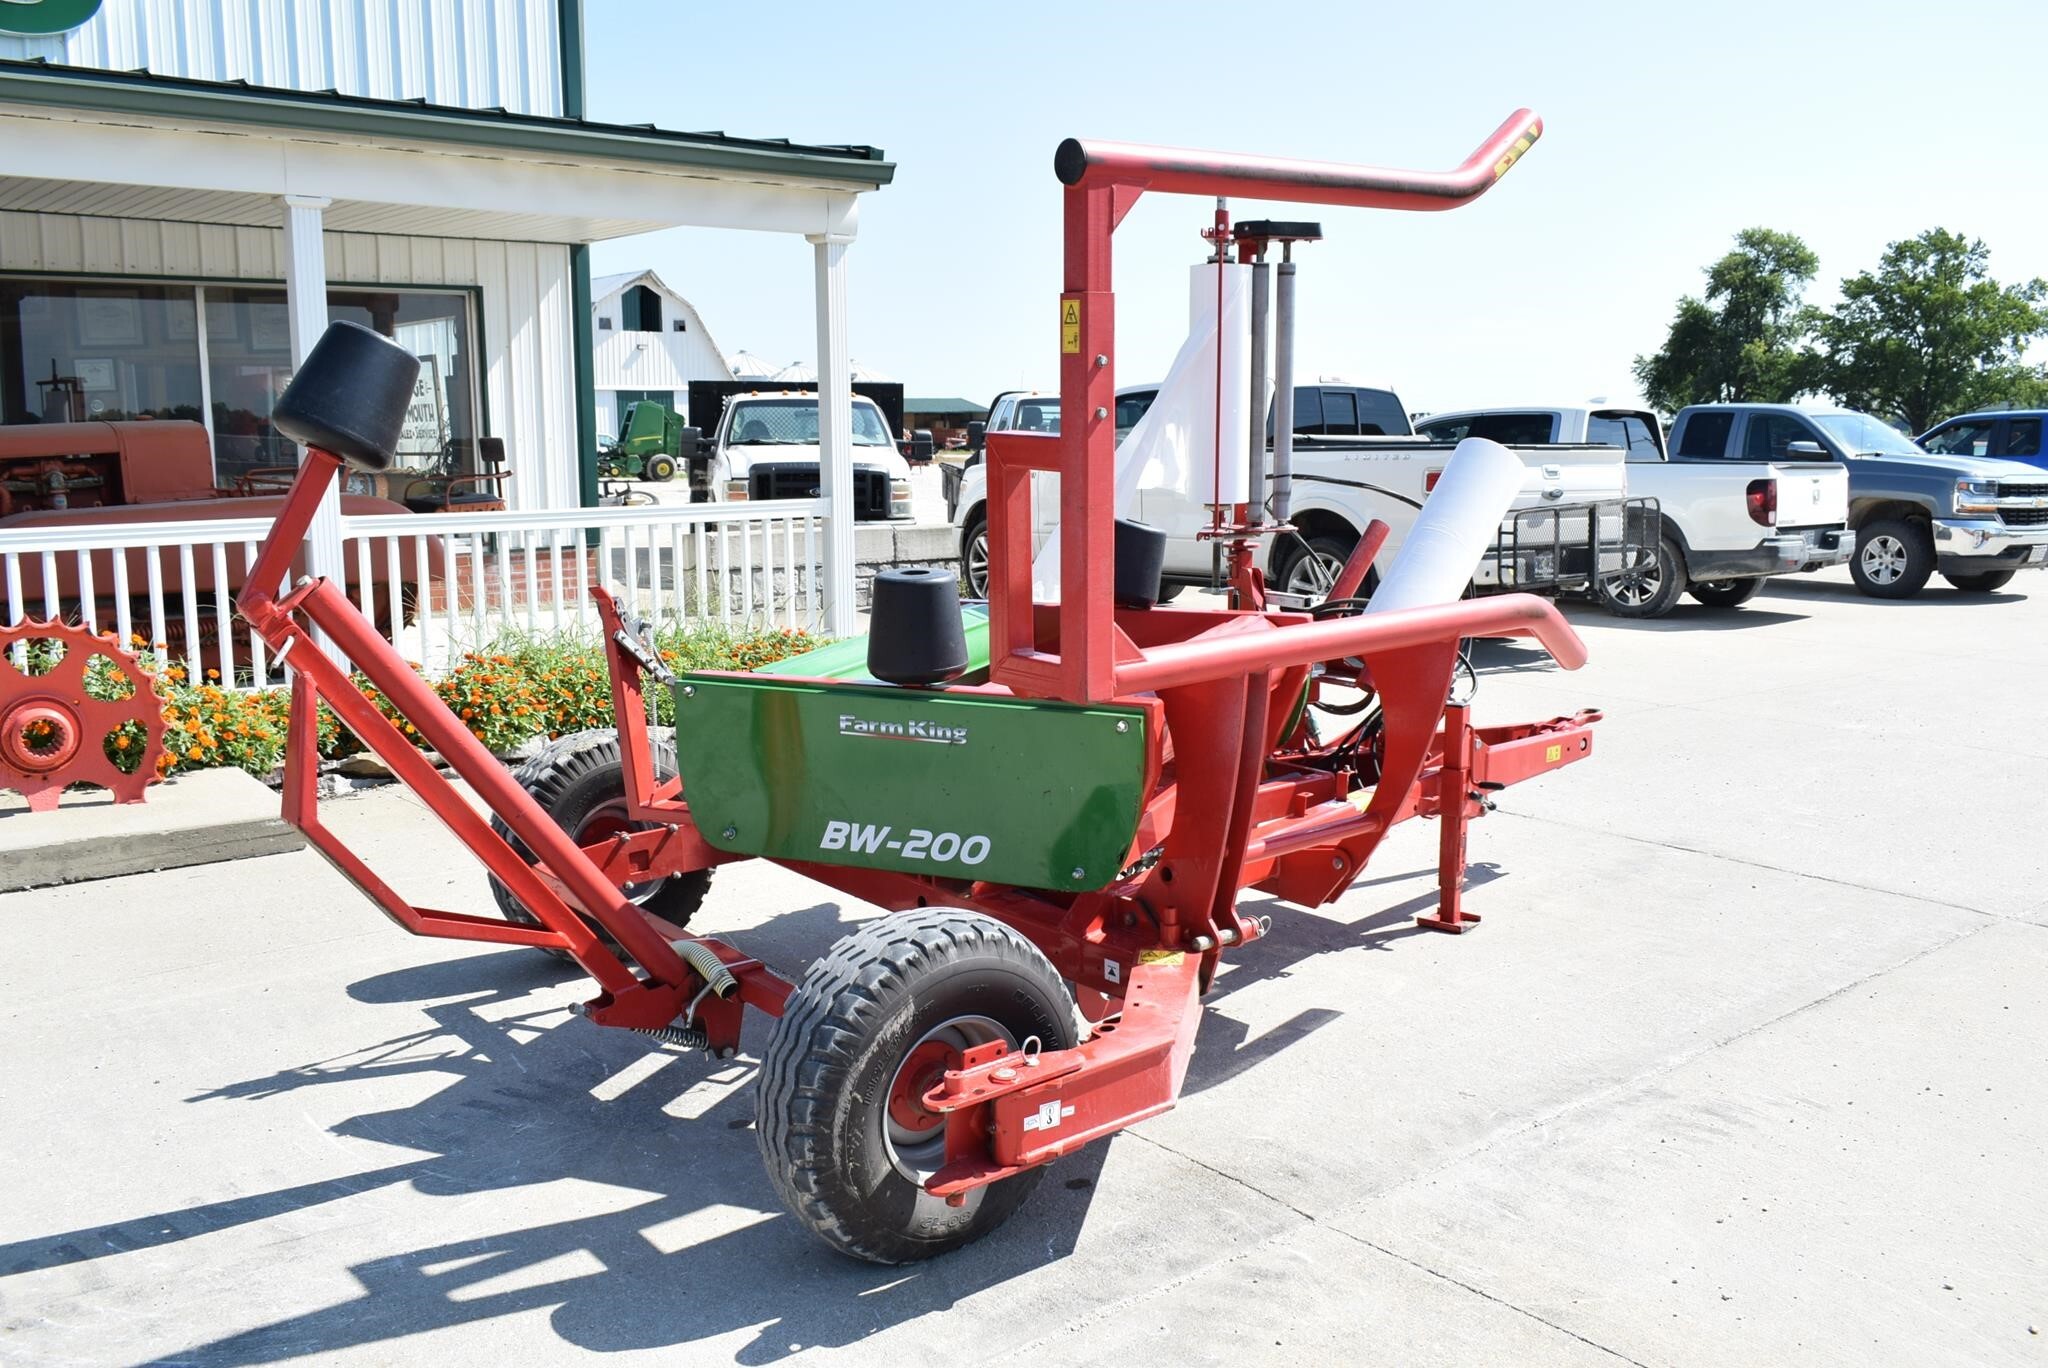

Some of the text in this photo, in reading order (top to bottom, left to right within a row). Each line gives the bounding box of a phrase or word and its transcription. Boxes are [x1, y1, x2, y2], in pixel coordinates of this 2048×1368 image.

[405, 403, 435, 423] MOUTH
[839, 714, 968, 744] Farm King
[819, 820, 991, 865] BW-200
